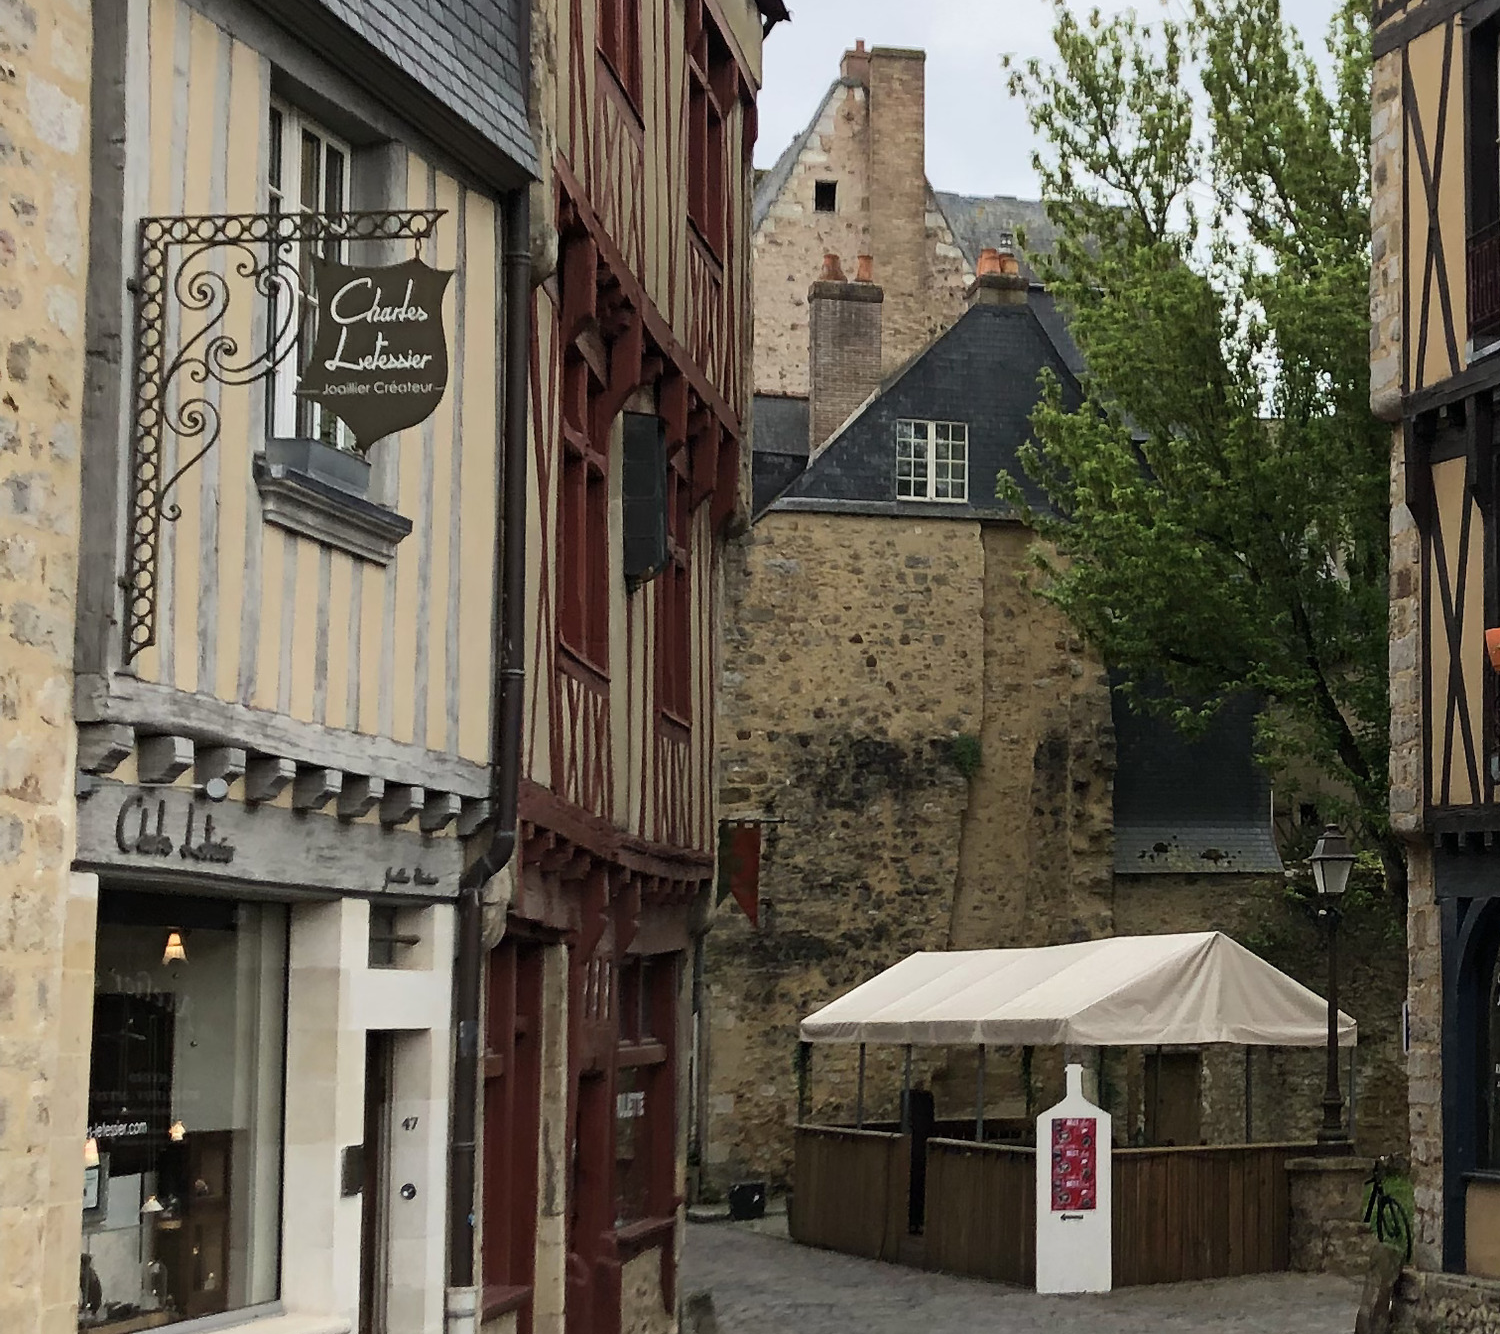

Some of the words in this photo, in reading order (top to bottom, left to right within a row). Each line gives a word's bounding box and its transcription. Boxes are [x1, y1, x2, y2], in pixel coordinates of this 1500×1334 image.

[330, 277, 429, 325] Charles
[324, 326, 432, 371] Letessier
[322, 383, 371, 396] Joaillier
[373, 380, 434, 395] Créateur
[402, 1116, 418, 1130] 47
